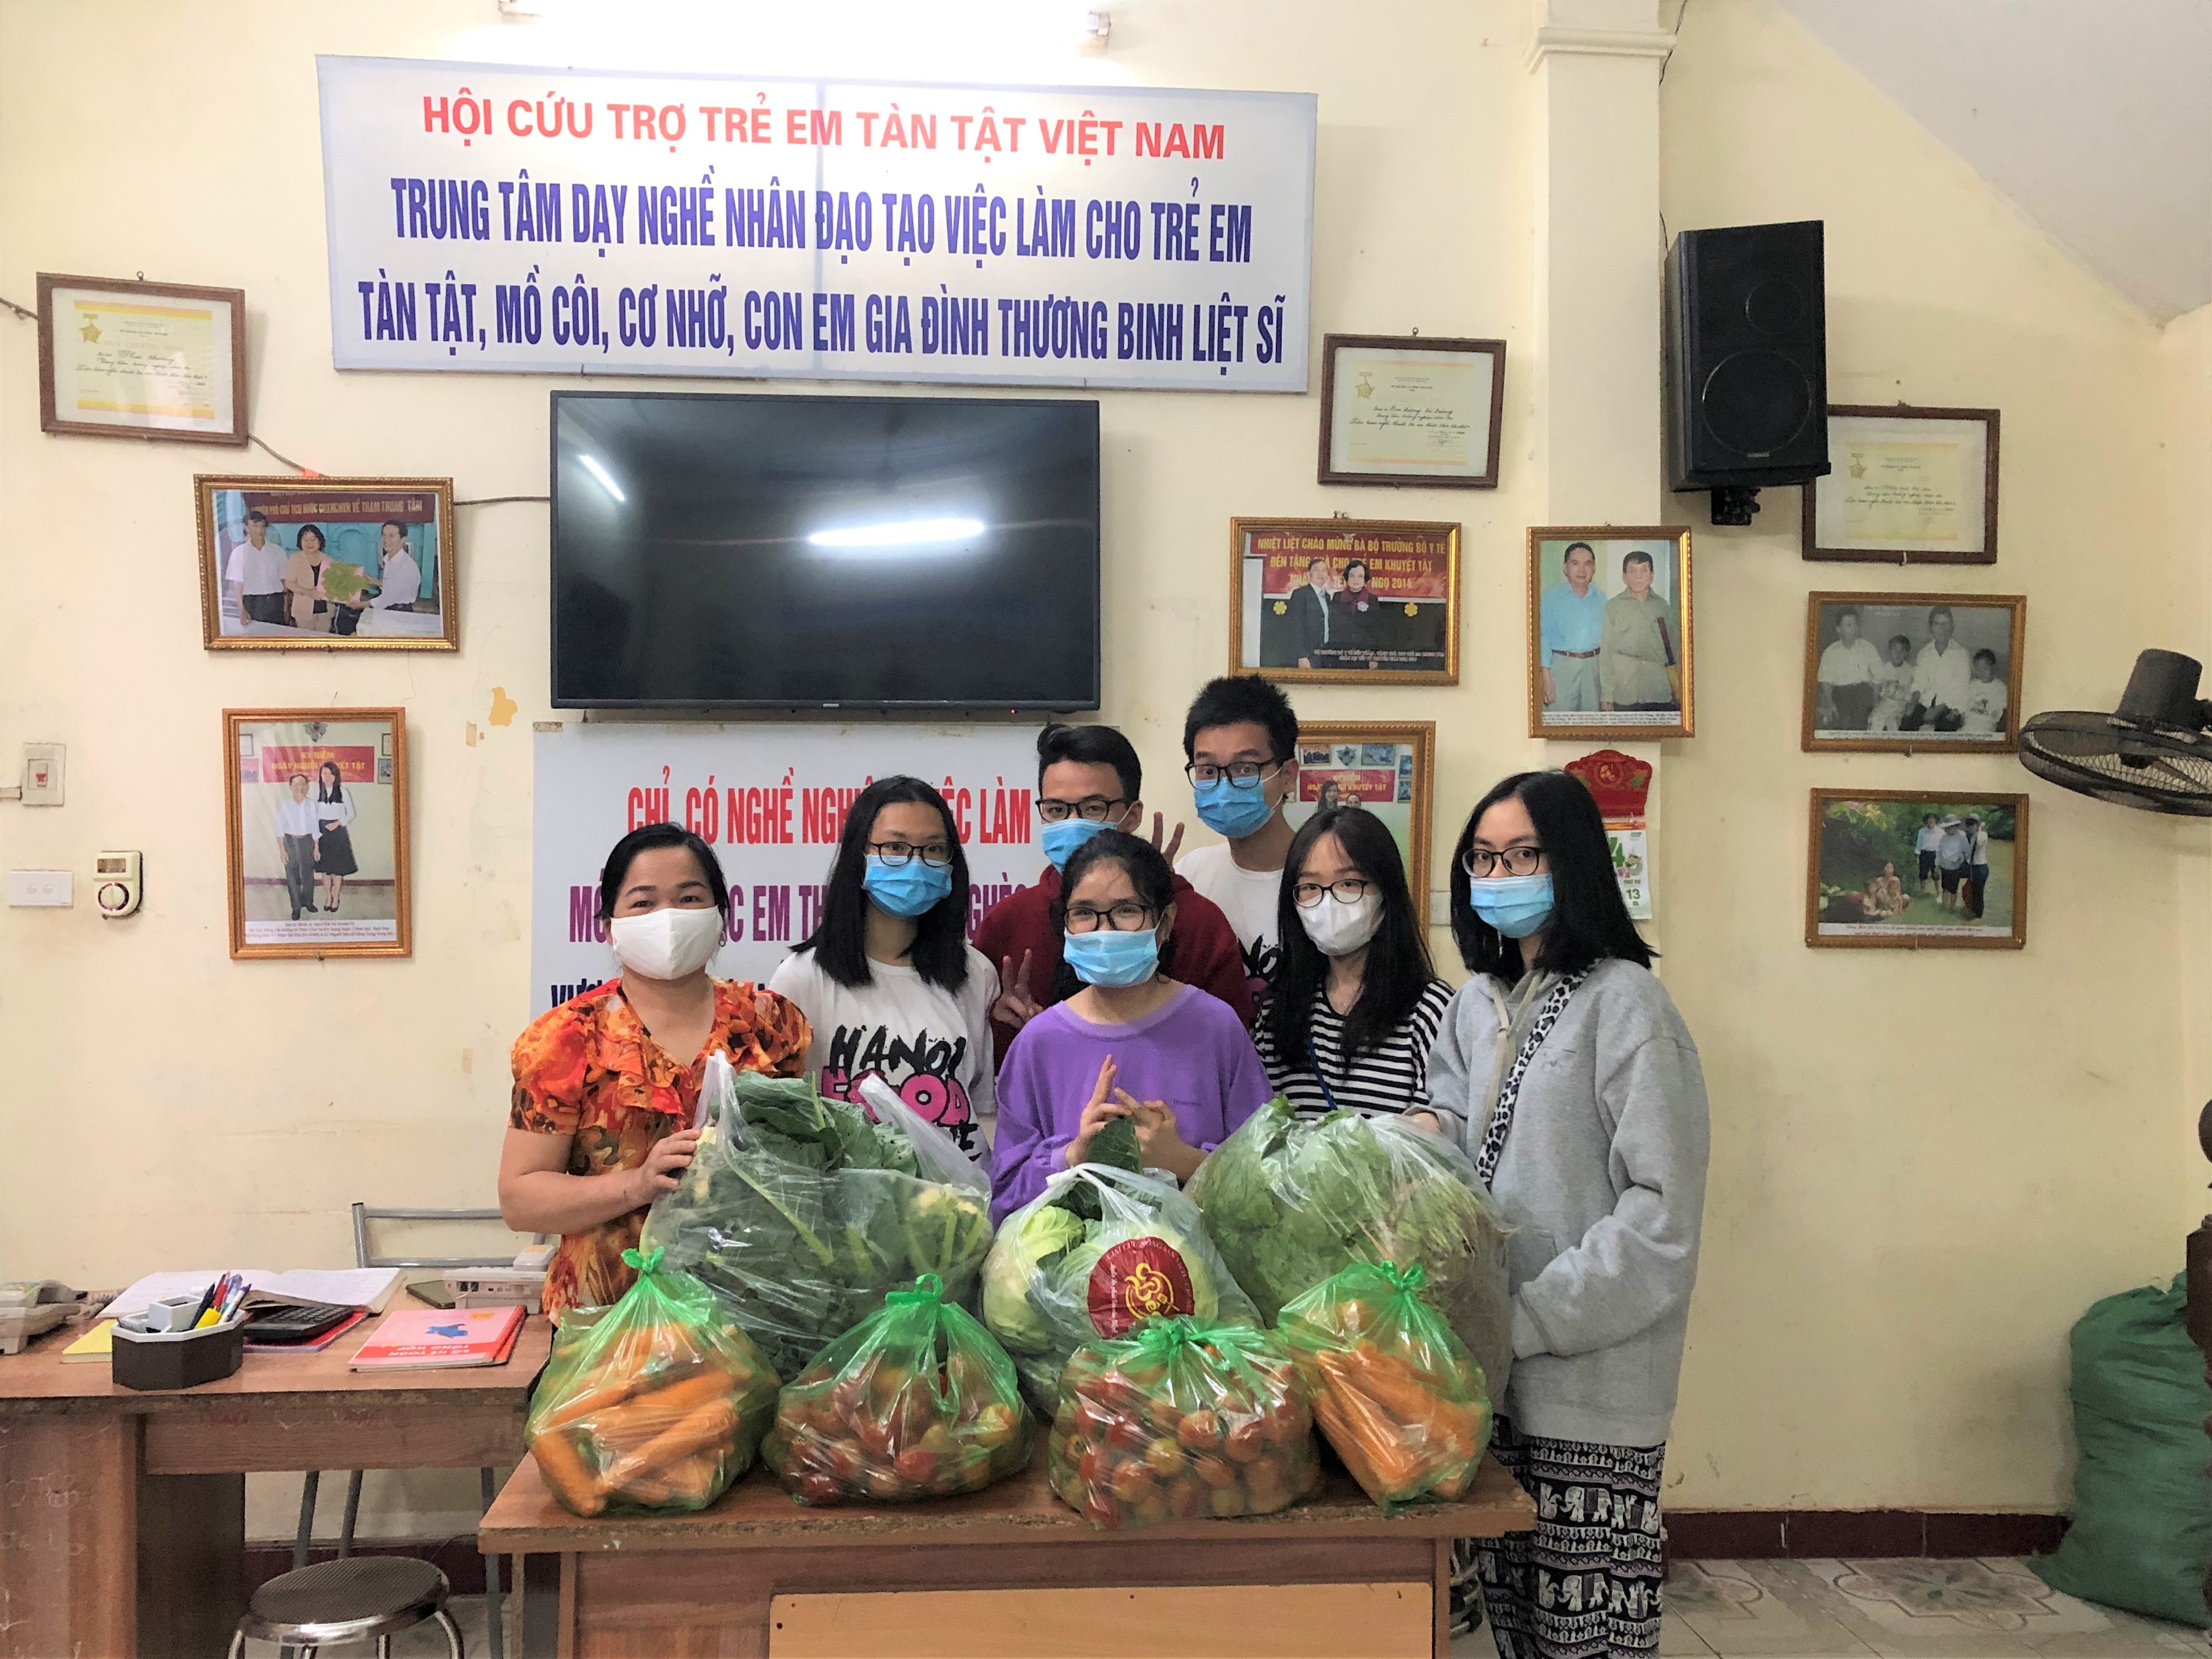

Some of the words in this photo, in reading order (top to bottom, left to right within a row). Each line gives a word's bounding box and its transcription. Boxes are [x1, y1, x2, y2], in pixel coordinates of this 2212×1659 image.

[423, 87, 492, 147] HỘI
[507, 90, 593, 139] CỨU
[607, 103, 686, 153] TRỢ
[699, 92, 771, 143] TRẺ
[787, 109, 842, 145] EM
[856, 103, 936, 149] TÀN
[951, 107, 1026, 163] TẬT
[1039, 110, 1123, 166] VIỆT
[1136, 122, 1224, 160] NAM
[391, 178, 490, 241] TRUNG
[498, 169, 561, 242] TÂM
[572, 184, 627, 257] DẠY
[639, 165, 715, 246] NGHỀ
[726, 176, 806, 249] NHÂN
[815, 191, 872, 264] ĐẠO
[882, 193, 935, 266] TẠO
[945, 184, 1006, 268] VIỆC
[1017, 185, 1076, 257] LÀM
[1086, 199, 1140, 260] CHO
[1151, 177, 1200, 261] TRẺ
[1210, 205, 1252, 263] EM
[359, 268, 416, 341] TÀN
[425, 270, 486, 356] TẬT,
[496, 265, 542, 345] MỒ
[552, 273, 609, 354] CÔI,
[619, 284, 658, 347] CƠ
[666, 273, 734, 356] NHỠ,
[744, 290, 803, 351] CON
[813, 293, 855, 352] EM
[865, 294, 912, 354] GIA
[921, 284, 989, 356] ĐÌNH
[998, 293, 1107, 360] THƯƠNG
[1118, 302, 1183, 361] BINH
[1193, 293, 1248, 375] LIỆT
[1257, 295, 1286, 364] SĨ
[1257, 536, 1281, 551] NHIỆT
[1283, 536, 1299, 551] LIỆT
[1302, 535, 1324, 550] CHÀO
[1381, 537, 1413, 554] TRƯỞNG
[1369, 558, 1383, 571] EM
[1385, 555, 1415, 573] KHUYẾT
[1392, 577, 1413, 589] 2014
[627, 765, 670, 834] CHỈ
[686, 775, 719, 845] CÓ
[727, 767, 794, 844] NGHỀ
[980, 776, 1031, 844] LÀM
[752, 885, 790, 942] EM
[1626, 888, 1641, 900] 13
[829, 1024, 967, 1081] HANOI
